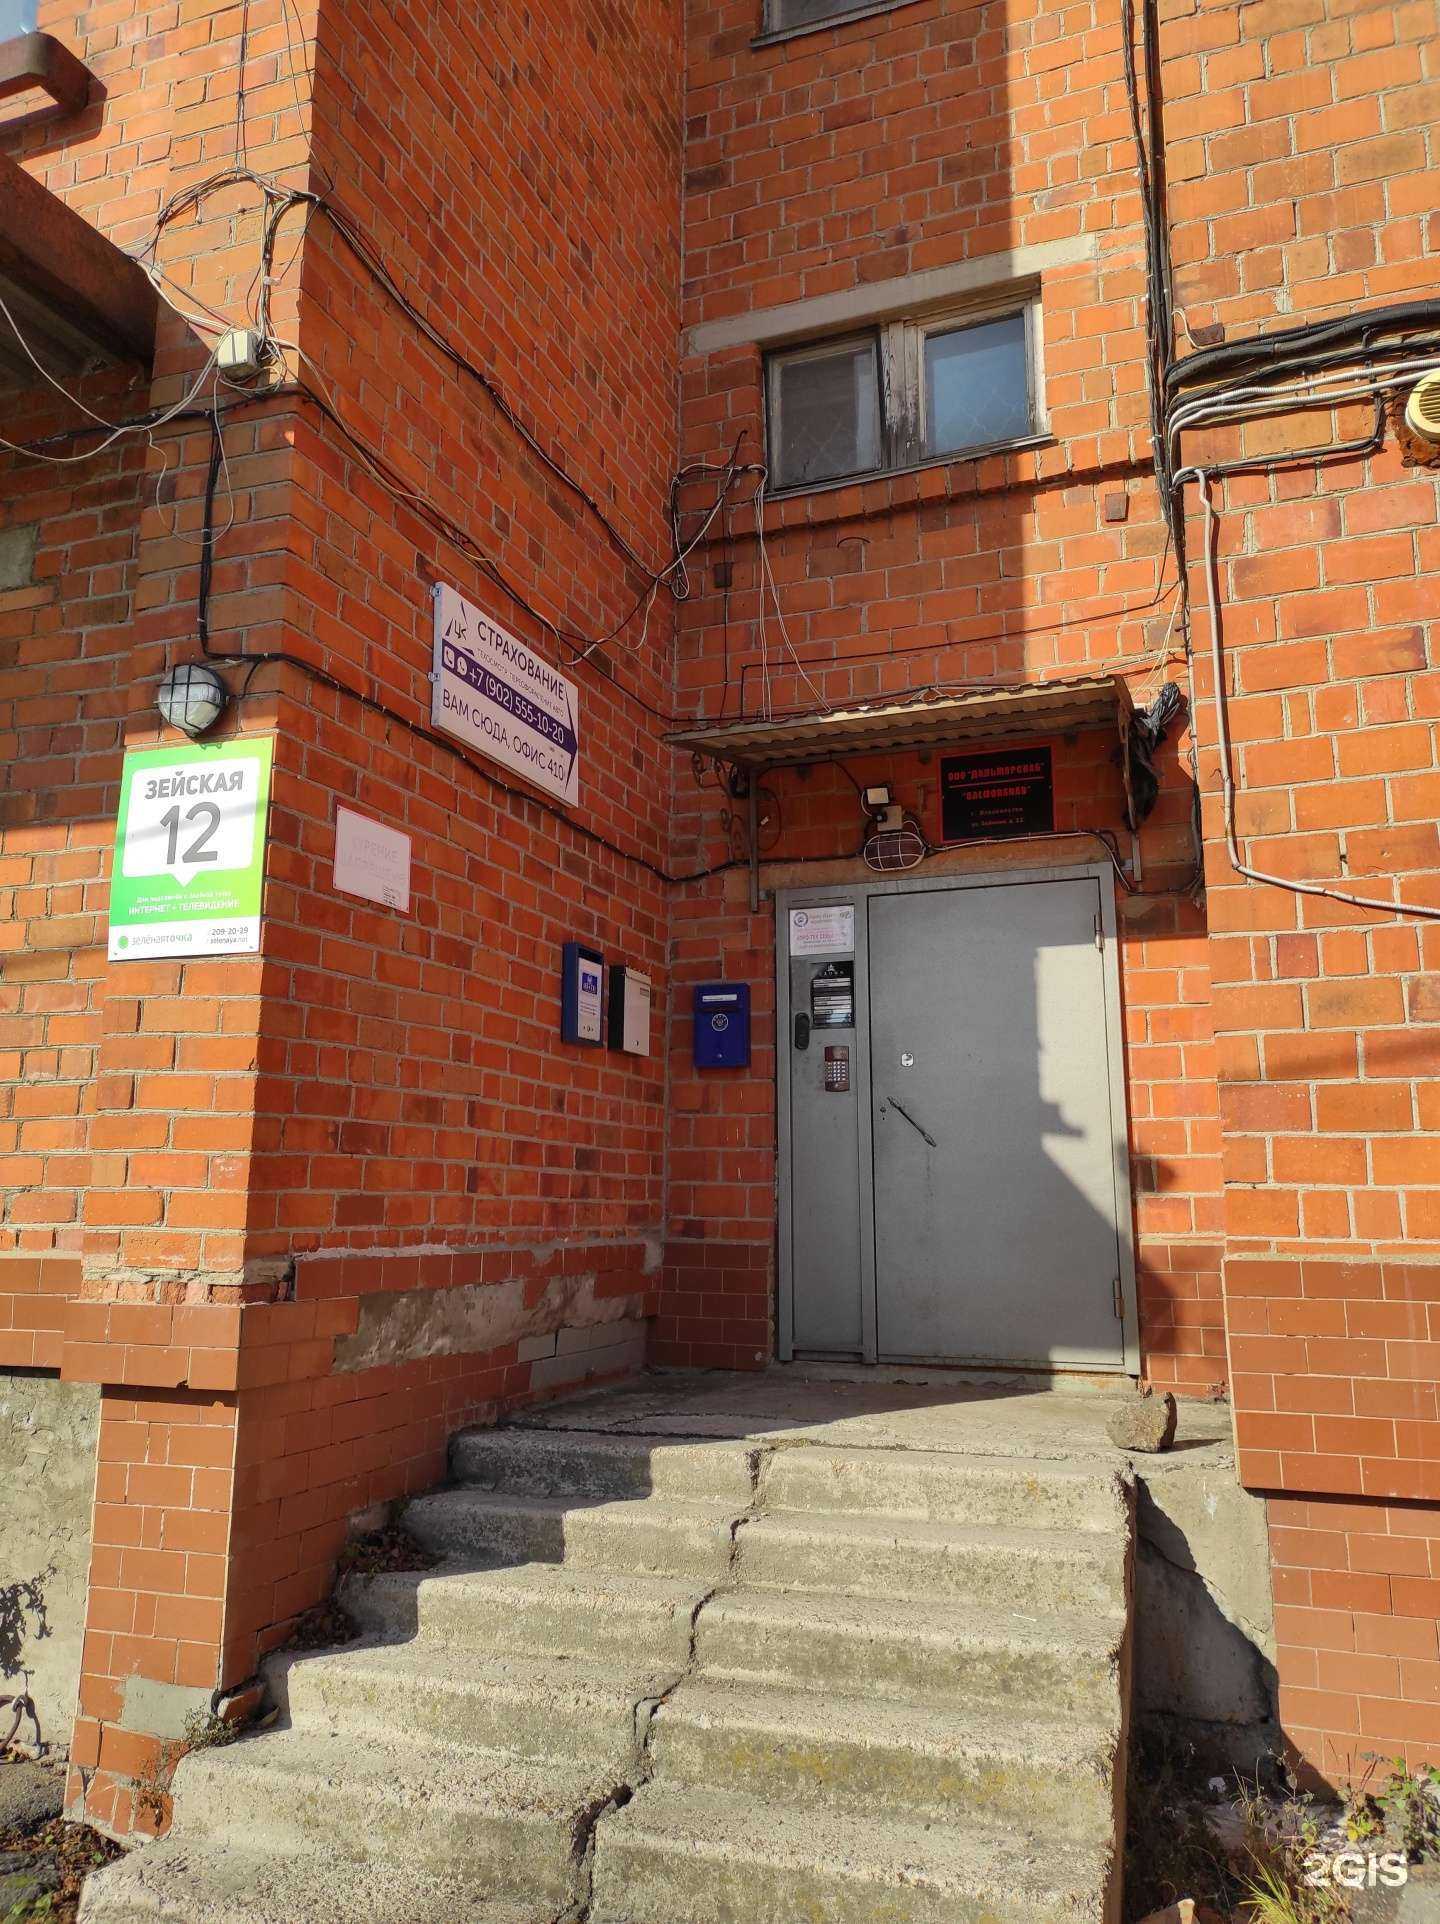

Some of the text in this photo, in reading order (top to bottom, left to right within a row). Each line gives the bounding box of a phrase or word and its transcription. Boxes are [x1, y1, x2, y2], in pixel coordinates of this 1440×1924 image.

[477, 621, 564, 701] СТРАХОВАНИЕ
[443, 690, 565, 782] ВАМ СЮДА, ОФИС 410
[469, 667, 564, 745] +7 (902) 555-10-20
[144, 770, 244, 801] ЗЕЙСКАЯ
[159, 801, 222, 866] 12
